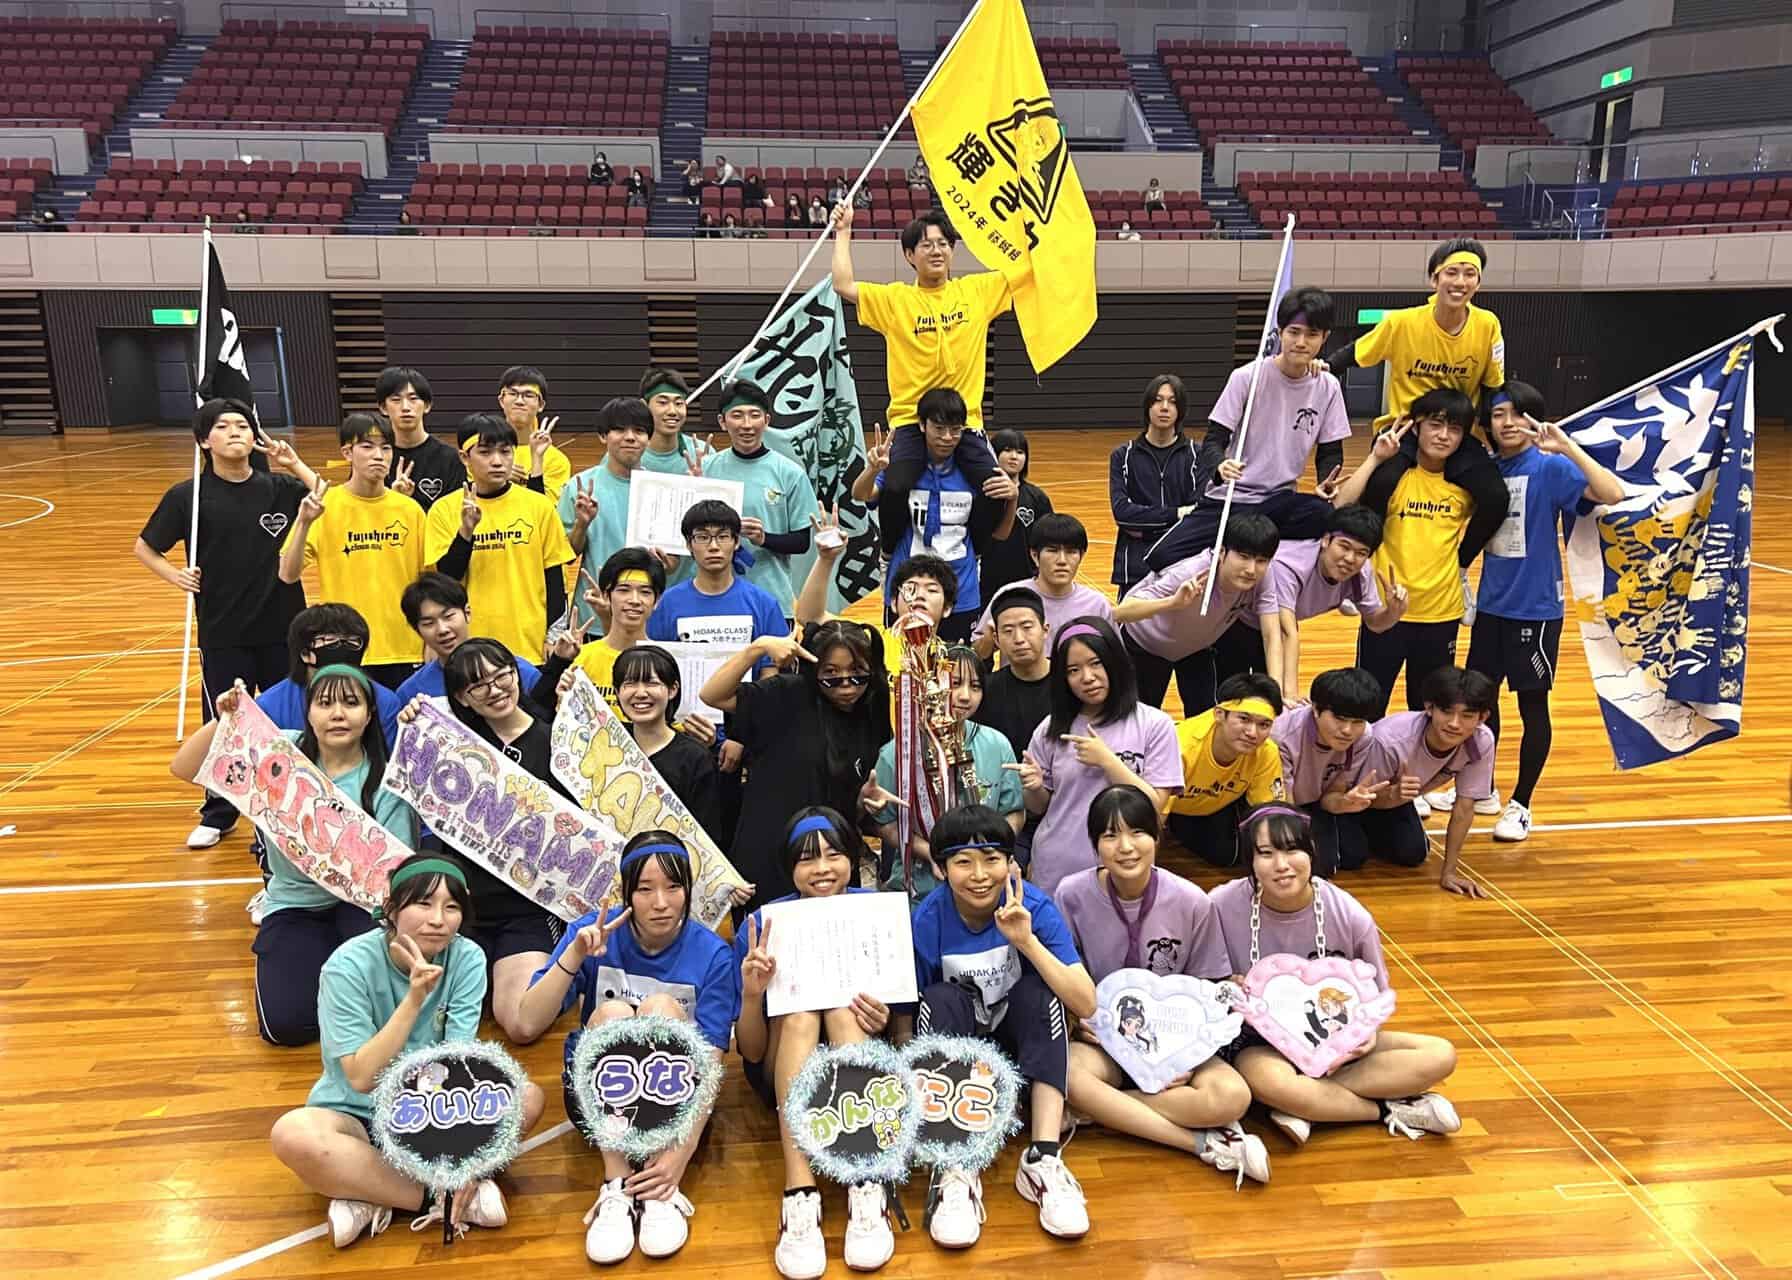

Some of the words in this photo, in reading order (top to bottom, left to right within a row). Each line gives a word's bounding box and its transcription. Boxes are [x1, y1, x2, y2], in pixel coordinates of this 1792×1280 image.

[945, 185, 989, 231] 2024年
[917, 311, 963, 326] fujihiro
[348, 529, 400, 543] fujishiro
[472, 529, 522, 543] ujishiro
[397, 723, 618, 905] HONAMI
[600, 1062, 687, 1099] らな
[391, 1086, 510, 1126] あいか
[810, 1080, 900, 1140] かんな
